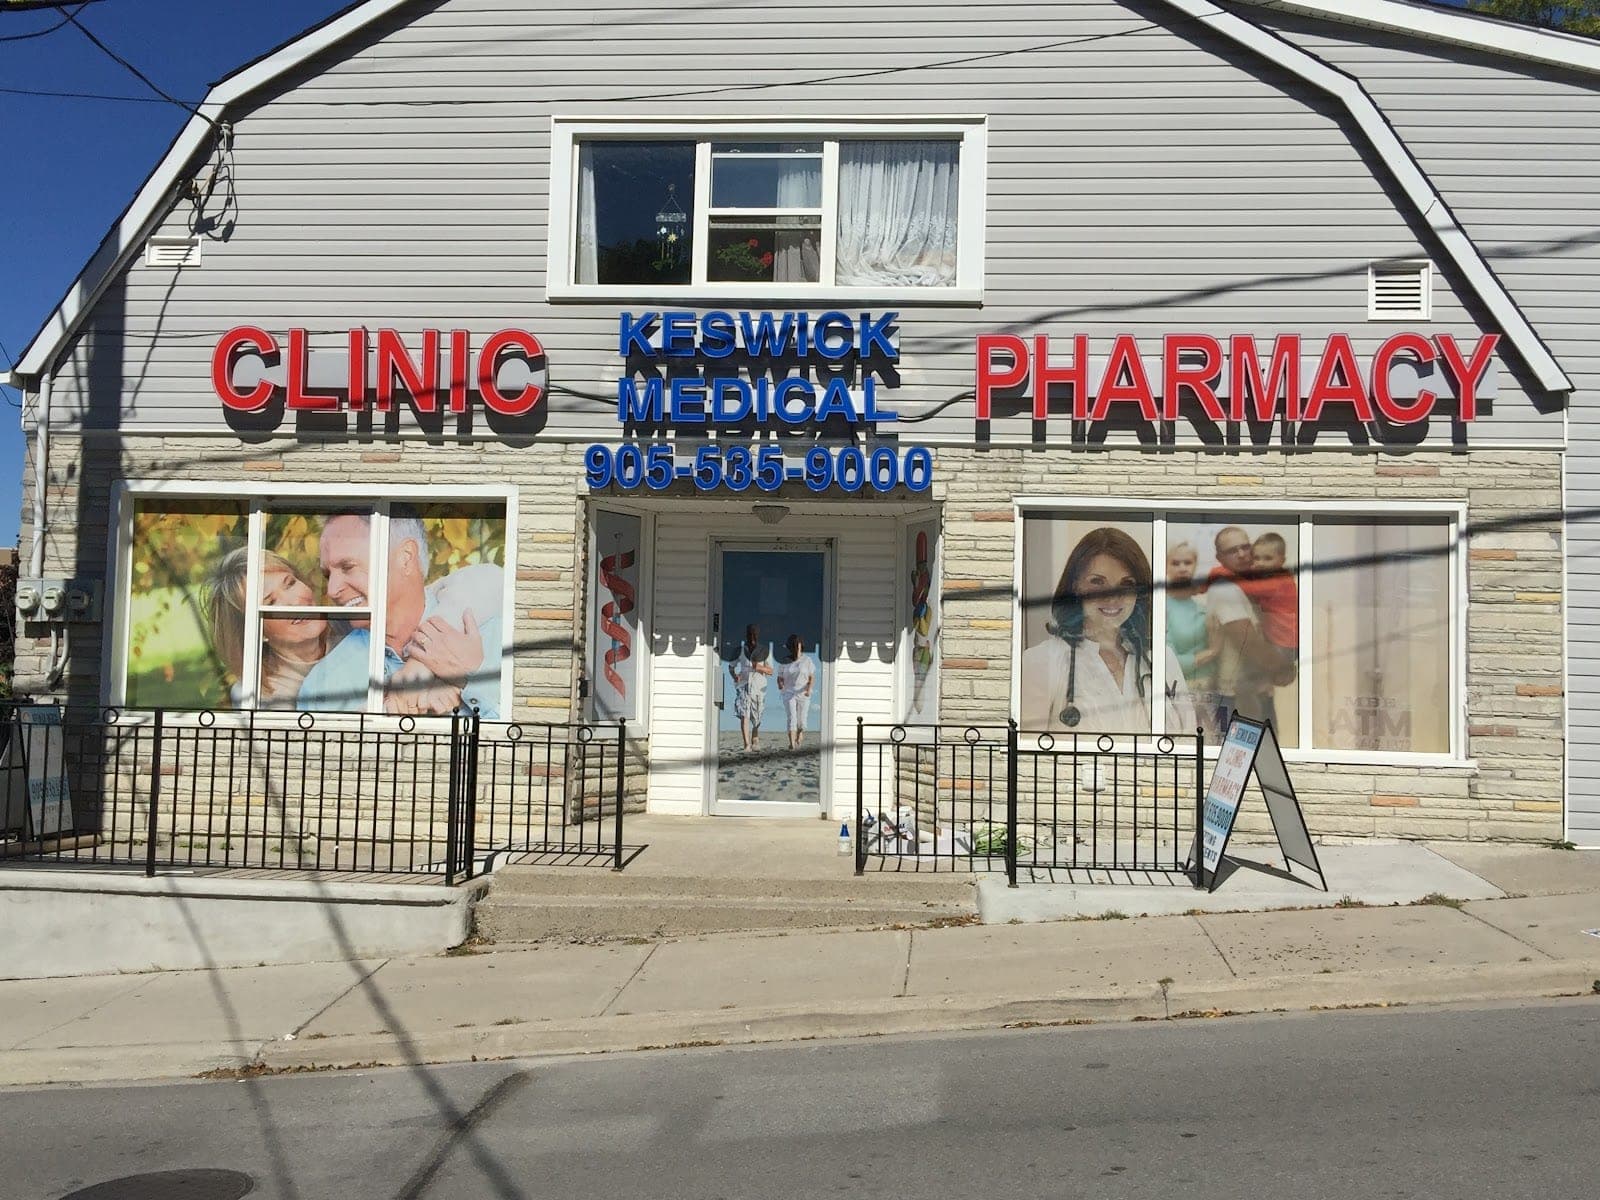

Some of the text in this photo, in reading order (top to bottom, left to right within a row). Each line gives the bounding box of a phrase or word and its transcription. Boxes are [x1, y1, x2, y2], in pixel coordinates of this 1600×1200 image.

[619, 311, 899, 358] KESWICK
[211, 325, 547, 416] CLINIC
[975, 332, 1501, 423] PHARMACY
[617, 376, 899, 424] MEDICAL
[584, 444, 933, 492] 905-535-9000
